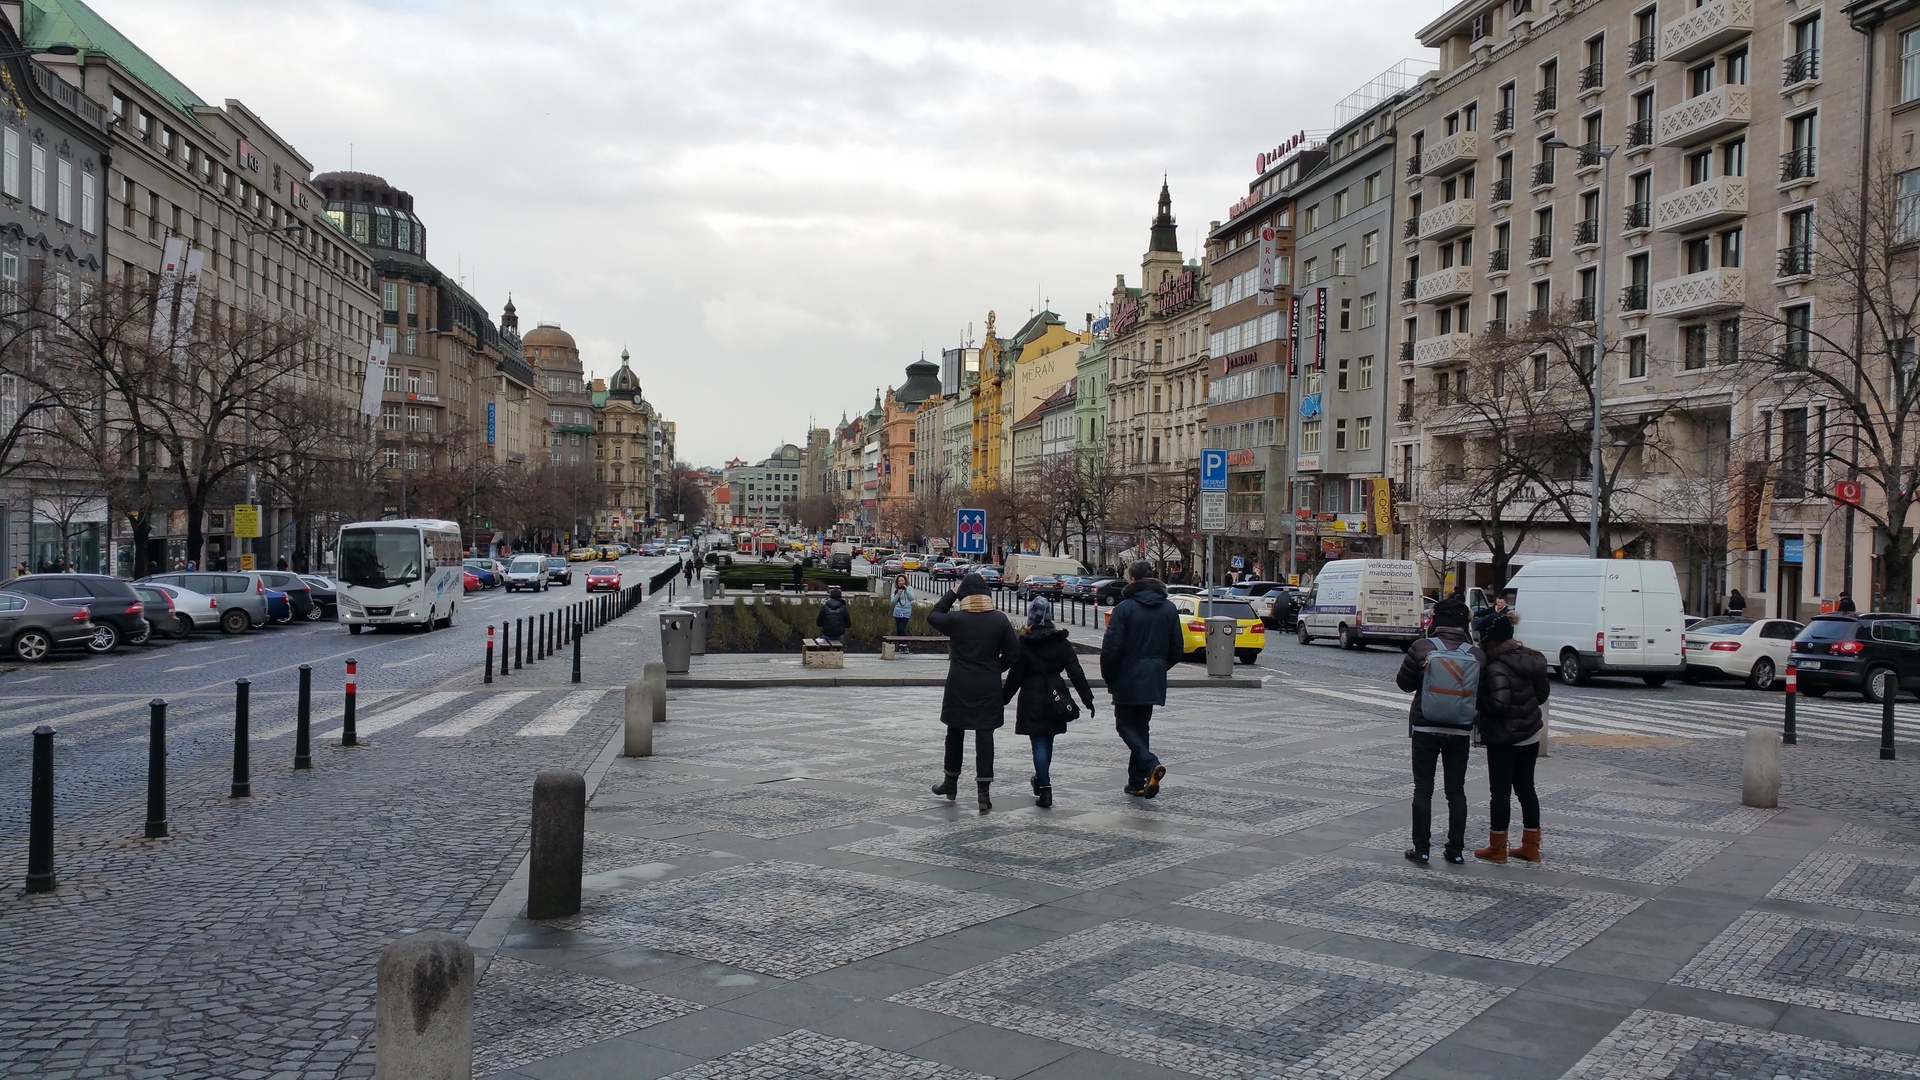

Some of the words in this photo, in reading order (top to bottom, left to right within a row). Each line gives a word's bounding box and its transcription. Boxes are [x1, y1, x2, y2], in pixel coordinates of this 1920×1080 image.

[1266, 129, 1305, 165] RAMADA
[248, 153, 260, 171] KB
[300, 193, 310, 210] KB
[1021, 361, 1055, 383] MERAN
[1206, 454, 1222, 477] P
[1379, 489, 1390, 524] COMO
[1368, 562, 1413, 570] velkoobchod
[1368, 570, 1413, 578] maloobchod
